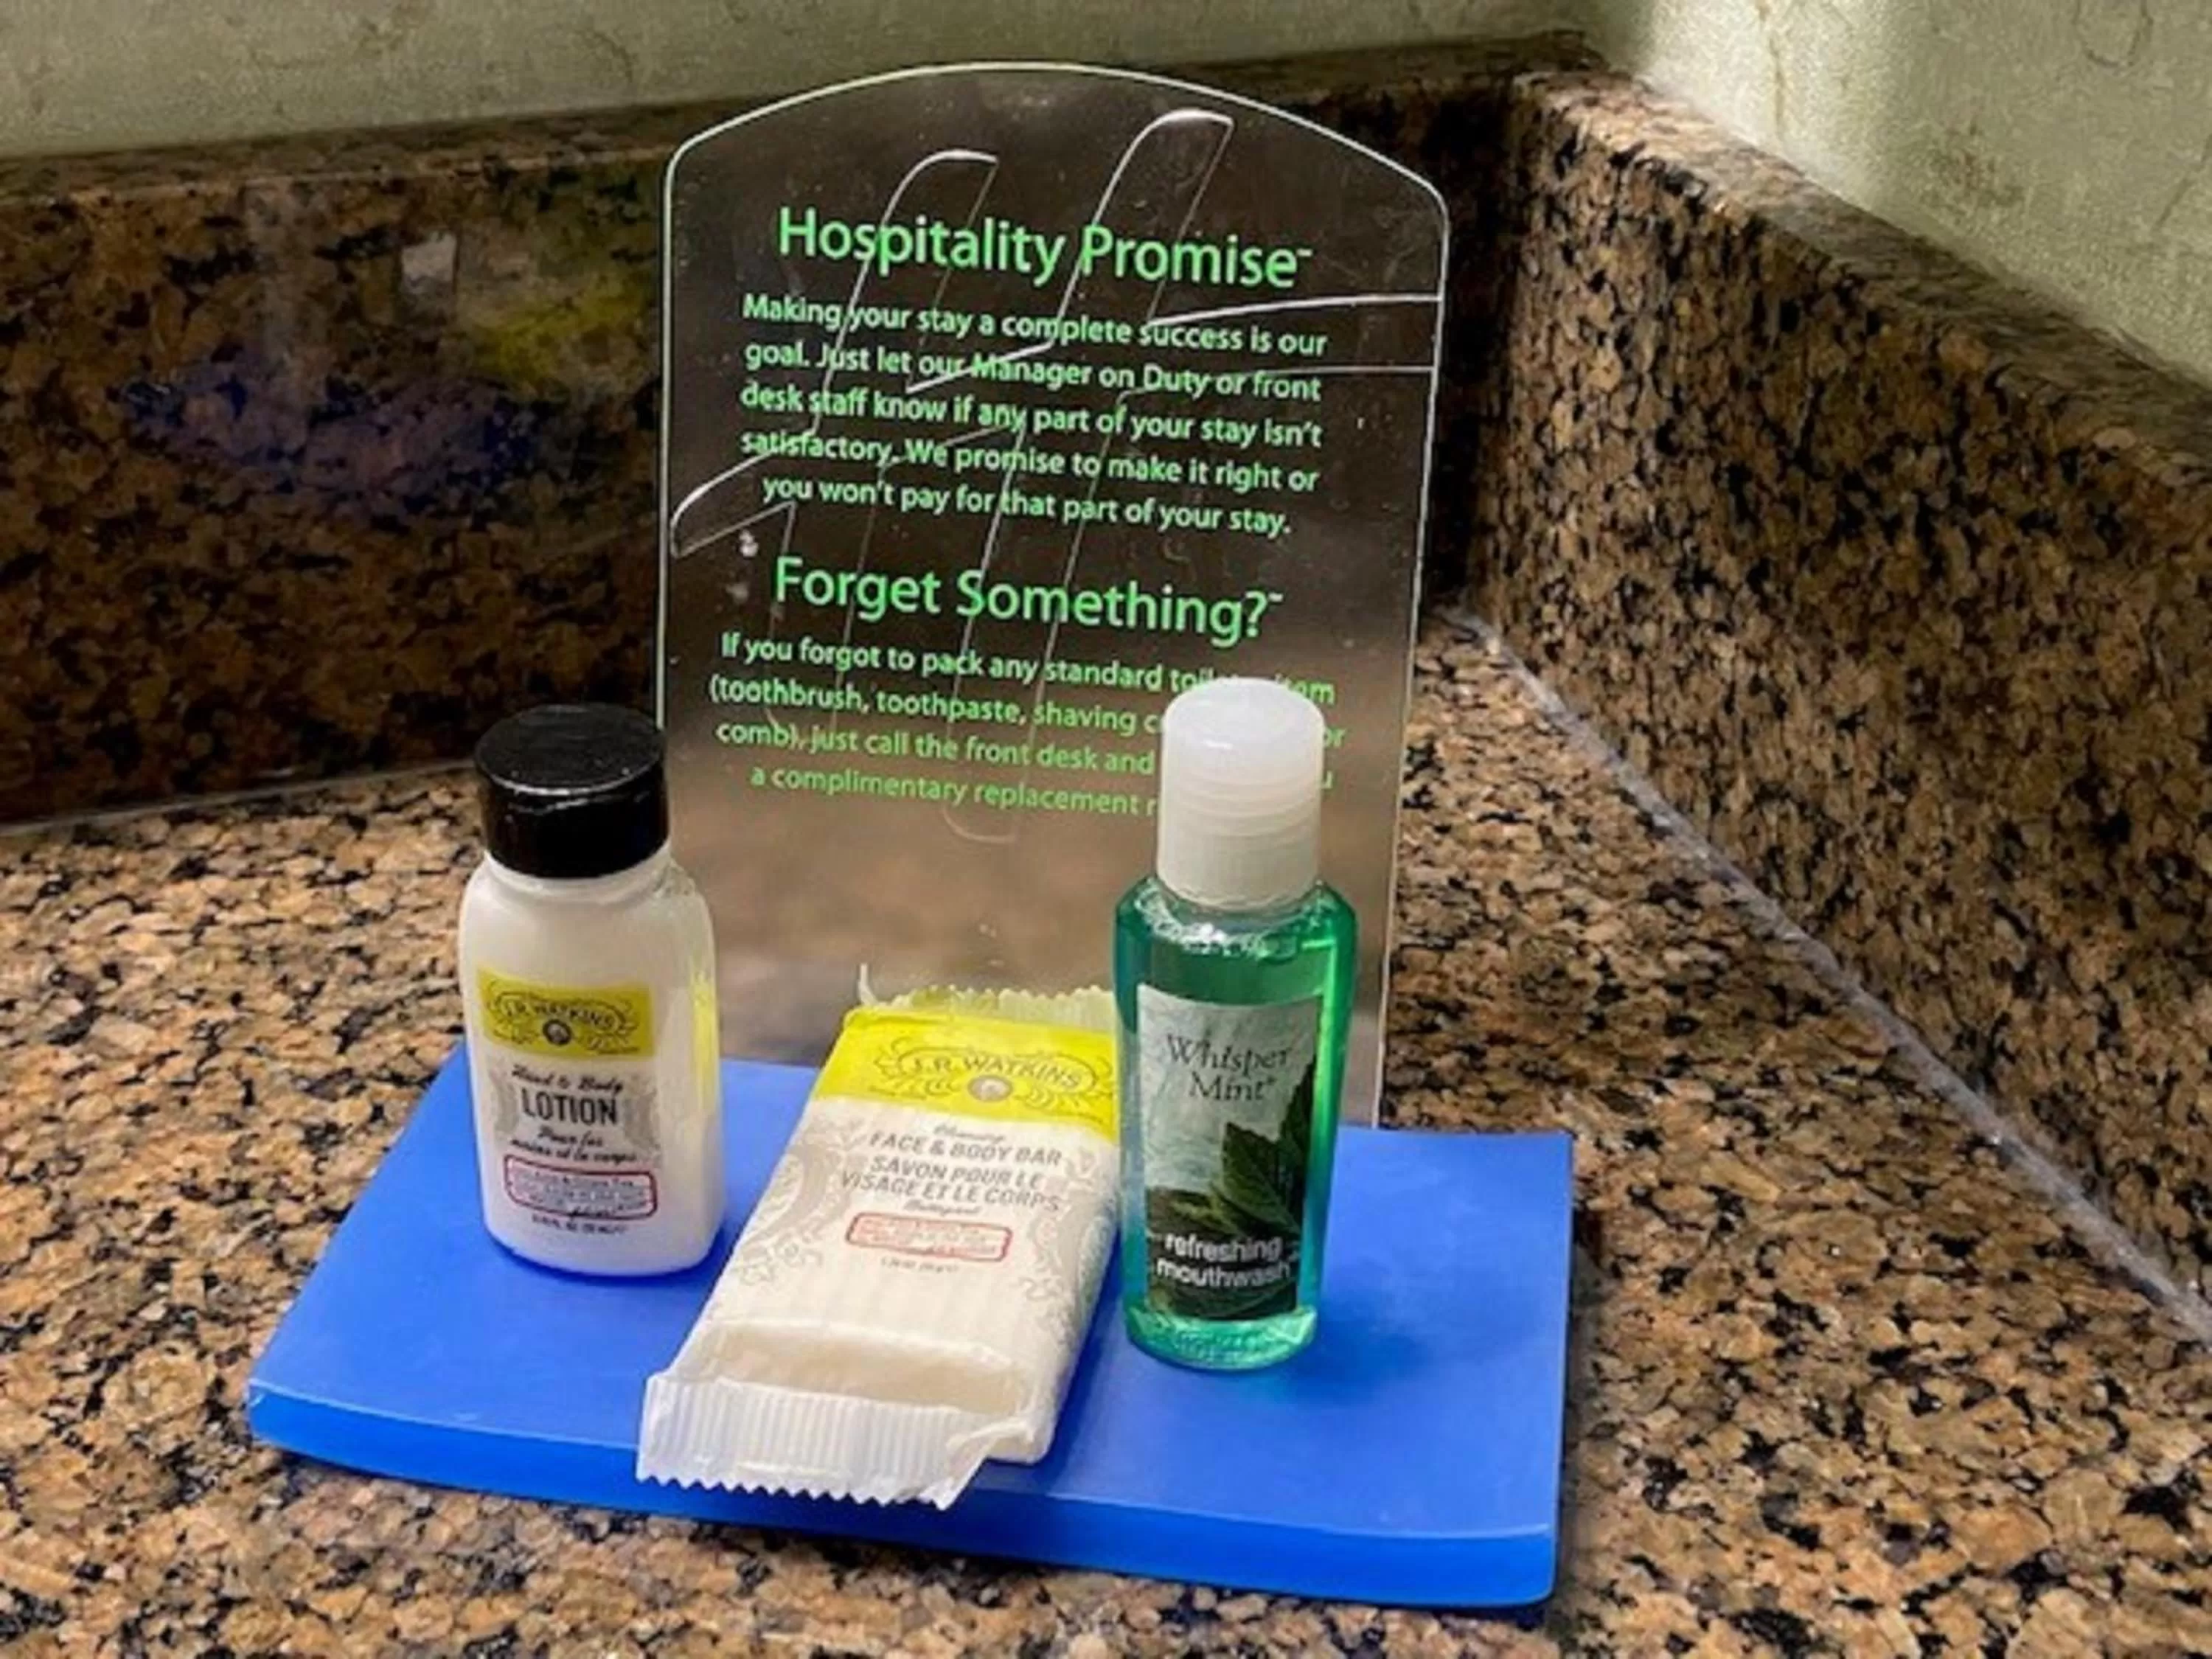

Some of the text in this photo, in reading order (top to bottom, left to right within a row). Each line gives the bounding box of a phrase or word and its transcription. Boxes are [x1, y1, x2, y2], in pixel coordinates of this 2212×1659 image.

[779, 206, 1066, 288] Hospitality
[742, 293, 1327, 357] Making your stay a complete success is our
[744, 339, 1322, 402] goal. Just let our Manager on Duty or front
[740, 380, 804, 413] desk
[809, 386, 869, 417] staff
[874, 390, 947, 422] know
[953, 394, 973, 423] if
[978, 403, 1026, 434] any
[1033, 408, 1091, 435] part
[1096, 403, 1128, 433] of
[1130, 414, 1195, 441] your
[1200, 418, 1257, 449] stay
[740, 431, 1319, 493] satisfactory. We promise to make it right or
[762, 476, 813, 504] you
[900, 487, 950, 515] pay
[956, 484, 995, 513] for
[1000, 490, 1056, 517] that
[1063, 499, 1119, 525] part
[1124, 497, 1156, 524] of
[1158, 507, 1223, 532] your
[1228, 509, 1292, 540] stay.
[775, 555, 942, 622] Forget
[721, 631, 741, 658] If
[744, 639, 793, 664] you
[799, 636, 882, 672] forgot
[887, 647, 916, 671] to
[922, 649, 984, 678] pack
[989, 655, 1040, 685] any
[1044, 660, 1164, 692] standard
[709, 672, 870, 714] (toothbrush,
[877, 690, 1028, 725] toothpaste,
[1033, 700, 1137, 737] shaving
[809, 725, 858, 755] just
[865, 730, 908, 755] call
[914, 732, 959, 761] the
[964, 735, 1029, 765] front
[1037, 743, 1098, 771] desk
[1105, 748, 1155, 775] and
[751, 766, 765, 787] a
[771, 768, 968, 807] complimentary
[973, 782, 1138, 815] replacement
[962, 1054, 1083, 1091] WATKINS
[1166, 1033, 1293, 1077] Whisper
[521, 1088, 617, 1126] LOTION
[869, 1130, 927, 1155] FACE
[929, 1138, 945, 1156] &
[949, 1141, 1013, 1163] BODY
[1015, 1146, 1062, 1166] BAR
[869, 1154, 948, 1181] SAVON
[949, 1165, 1013, 1187] POUR
[841, 1169, 918, 1197] VISAGE
[984, 1188, 1062, 1213] CORPS
[1156, 1257, 1290, 1287] mouthwash
[1164, 1232, 1284, 1263] refreshing
